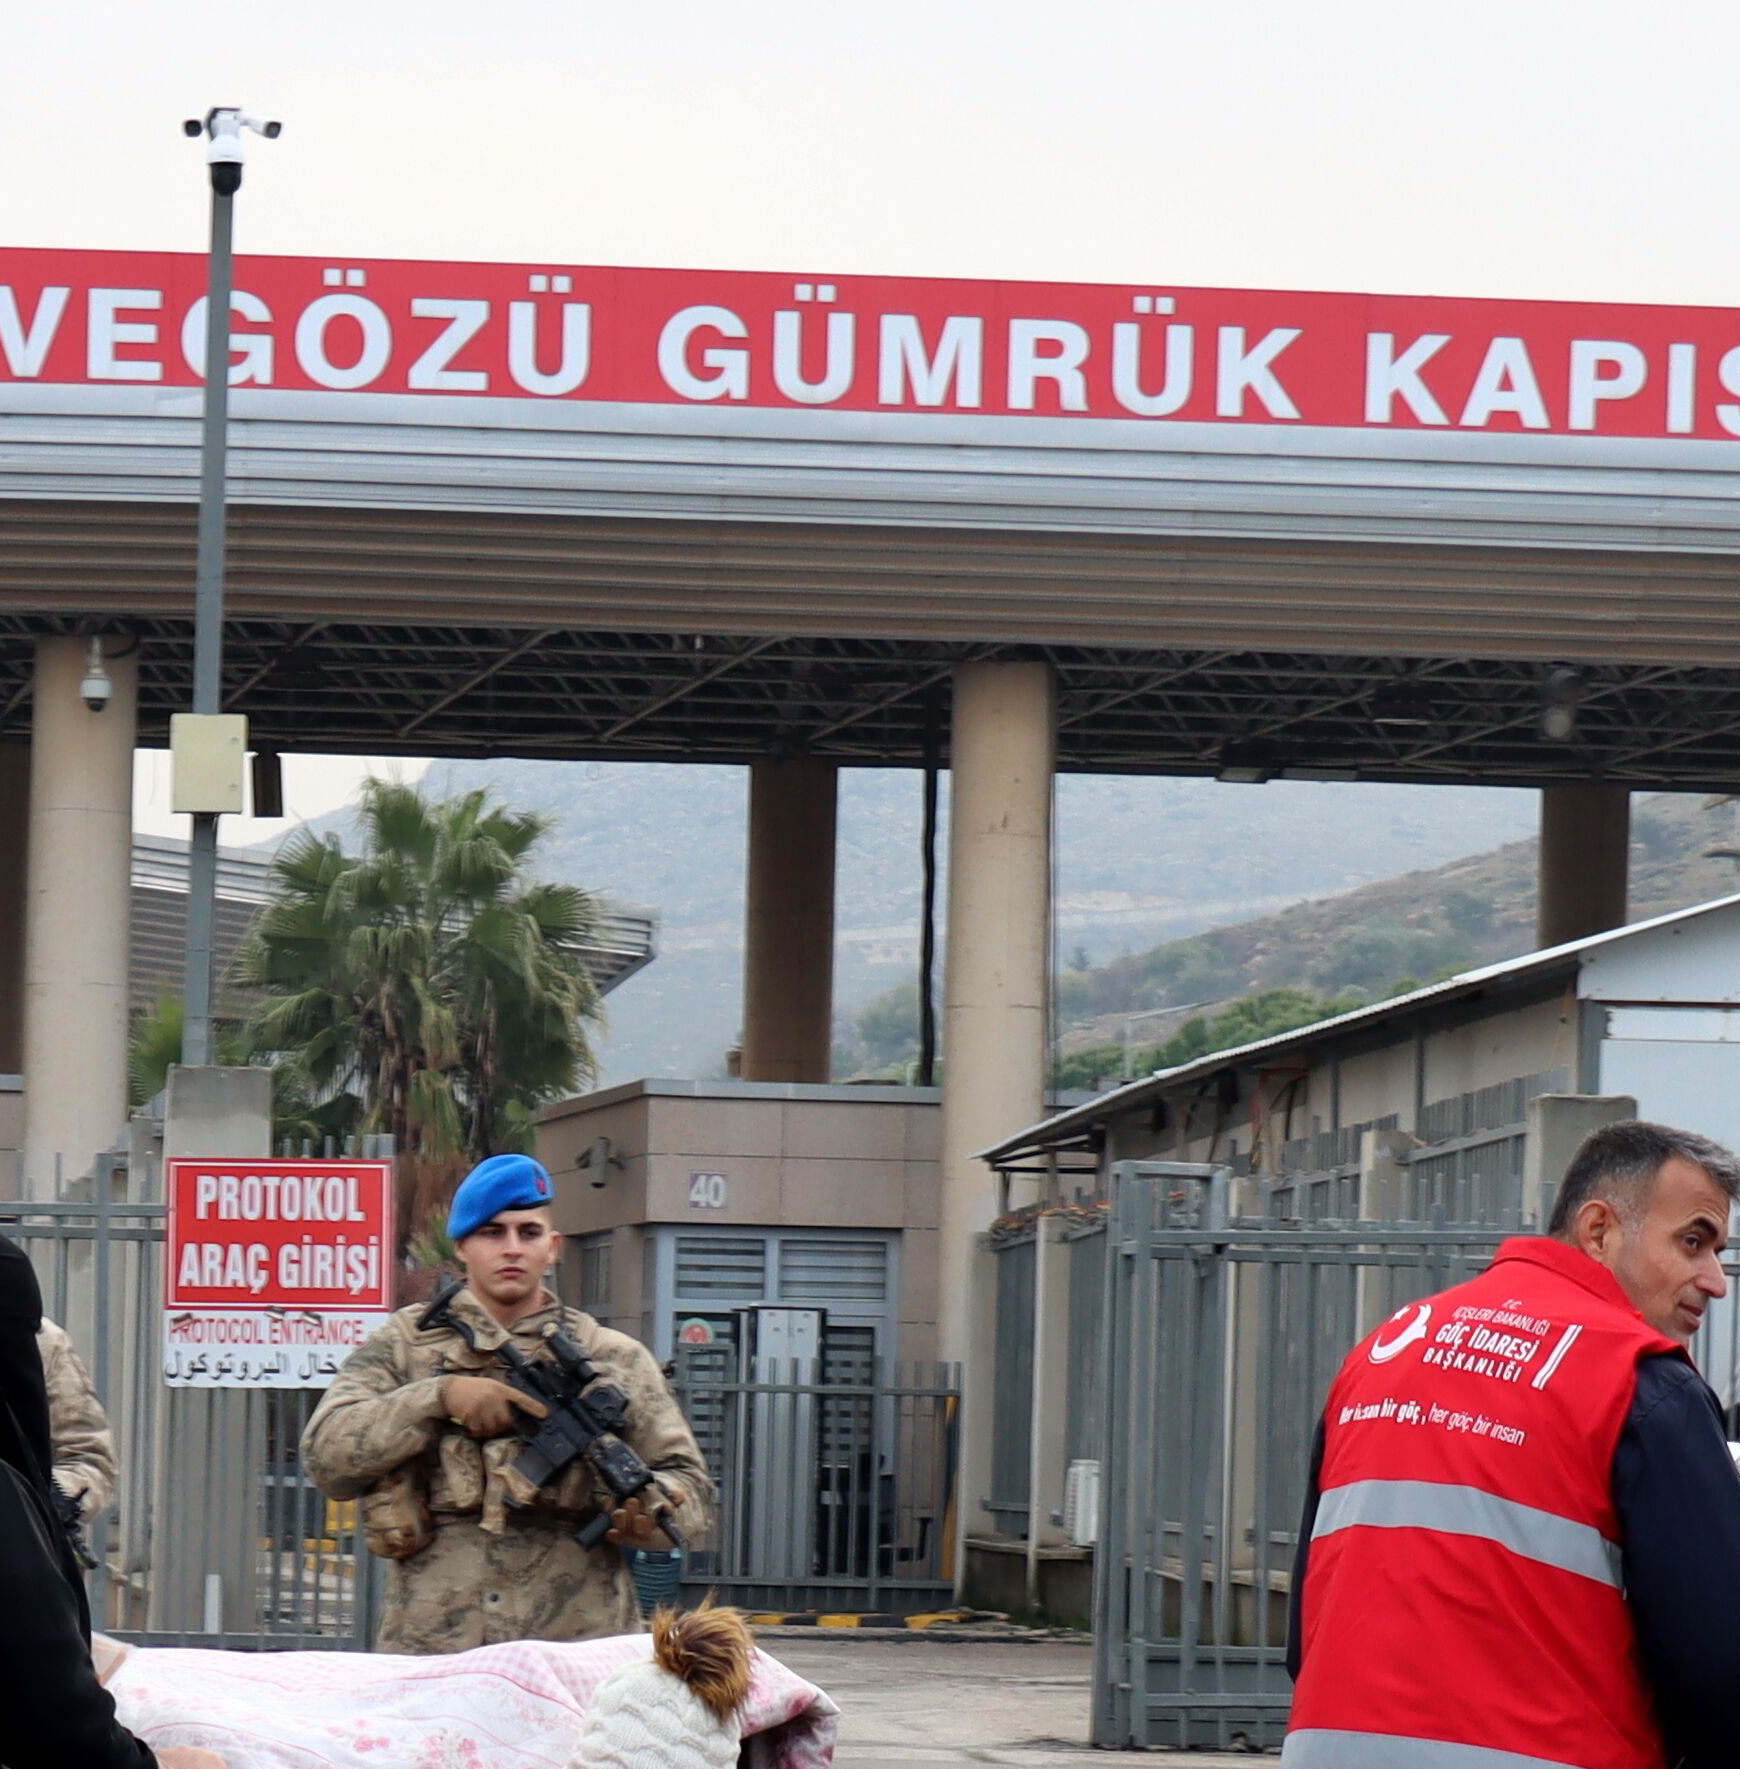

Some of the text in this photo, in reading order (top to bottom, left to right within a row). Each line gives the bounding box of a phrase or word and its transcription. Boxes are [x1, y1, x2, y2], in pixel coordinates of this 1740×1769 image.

[656, 284, 1304, 421] GÜMRÜK
[196, 1175, 365, 1222] PROTOKOL
[689, 1174, 726, 1208] 40
[178, 1234, 379, 1295] ARAÇ GİRİŞİ
[270, 1319, 365, 1345] ENTRANCE
[1435, 1321, 1540, 1363] GÖÇ İDARESİ
[1491, 1309, 1551, 1337] BAKANLIĞI
[1422, 1347, 1522, 1383] BAŞKANLIĞI
[1380, 1397, 1398, 1418] bir
[1428, 1402, 1450, 1424] her
[1446, 1411, 1473, 1433] göç
[1471, 1414, 1492, 1435] bir
[1489, 1419, 1526, 1447] insan
